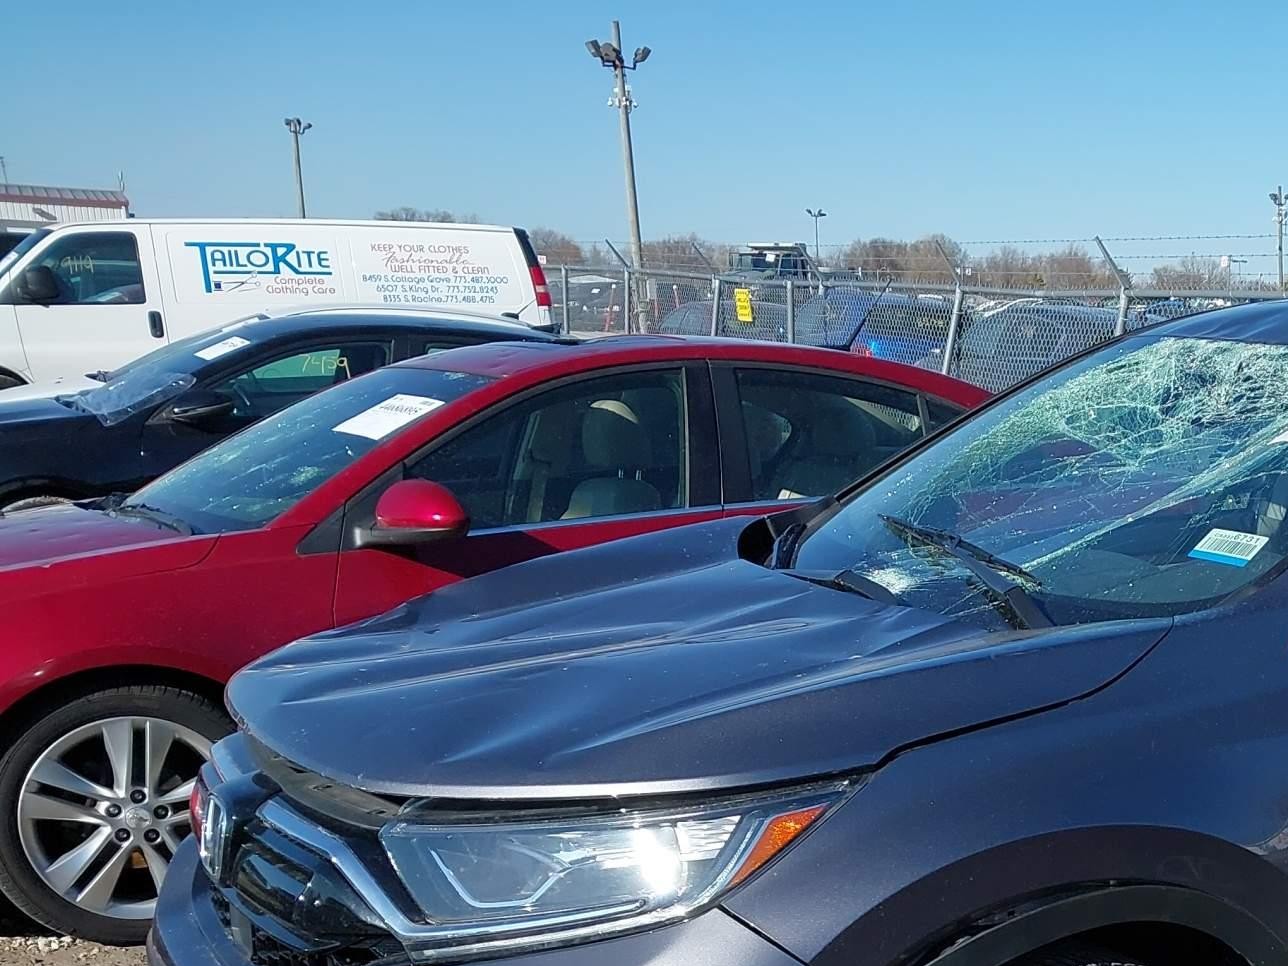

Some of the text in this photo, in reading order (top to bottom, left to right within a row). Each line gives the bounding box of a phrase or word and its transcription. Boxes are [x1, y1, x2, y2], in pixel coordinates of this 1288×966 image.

[370, 243, 470, 254] KEEP YOUR CLOTHES
[390, 264, 490, 275] WELL FITTED & CLEAN
[274, 276, 325, 288] Complete
[266, 285, 336, 297] Clothing Care
